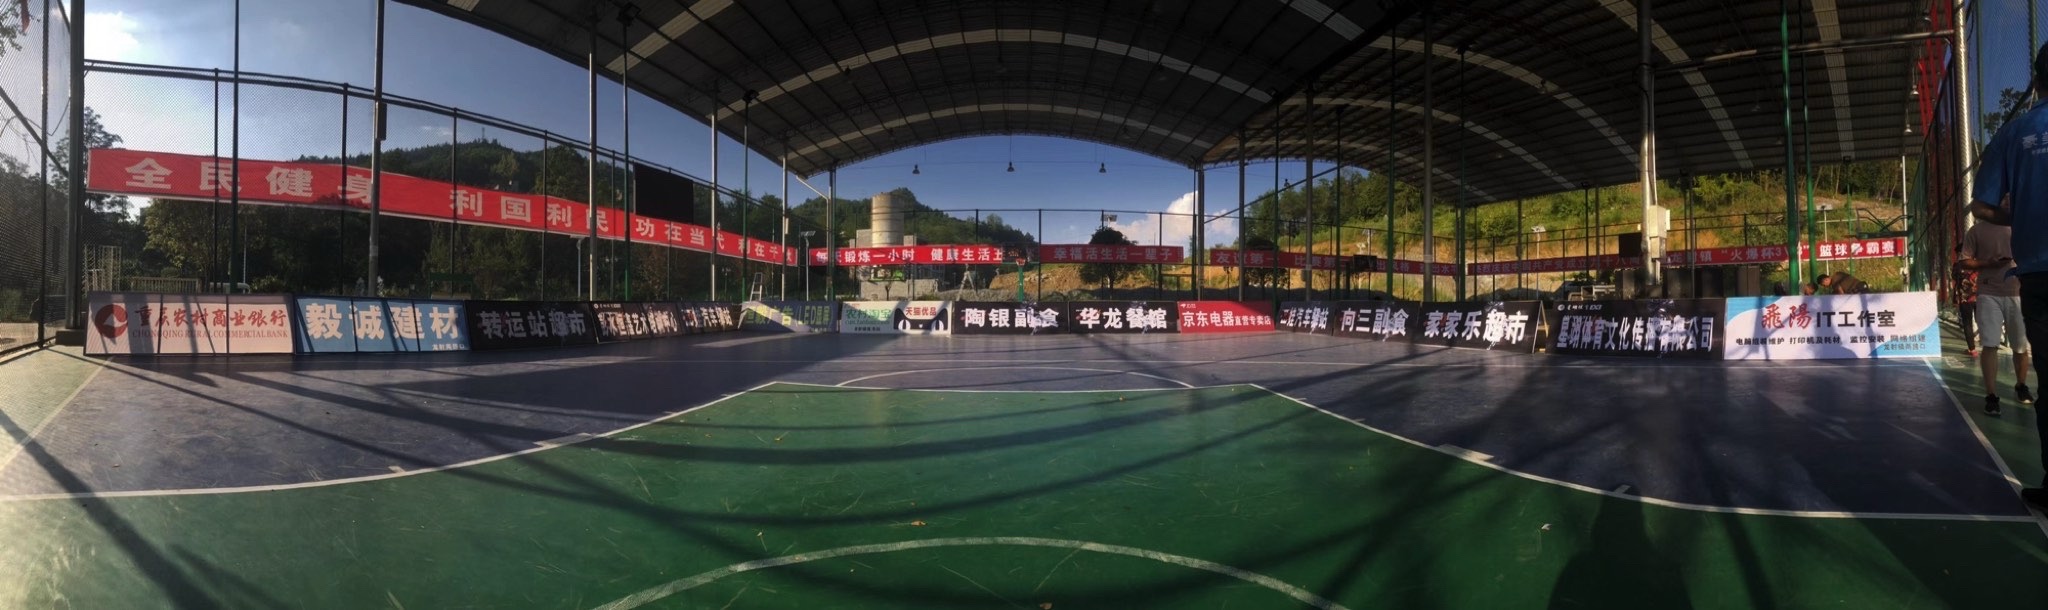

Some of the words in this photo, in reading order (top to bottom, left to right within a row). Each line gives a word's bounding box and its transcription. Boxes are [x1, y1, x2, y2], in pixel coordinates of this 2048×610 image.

[125, 157, 372, 204] 全民健身
[449, 189, 609, 232] 利国利民
[1819, 240, 1895, 258] 篮球争霸赛
[135, 305, 287, 327] 重庆农村商业银行
[305, 303, 459, 340] 毅诚建材
[905, 306, 937, 316] 天猫优品
[964, 307, 1059, 328] 陶银副食
[1080, 307, 1168, 329] 华龙餐馆
[1340, 307, 1410, 335] 向三副食
[267, 330, 288, 338] BANK
[480, 309, 586, 339] 转运站超市
[1424, 309, 1528, 344] 家家乐超市
[1789, 336, 1841, 345] 打印机及耗材
[1849, 335, 1885, 344] 监控安装
